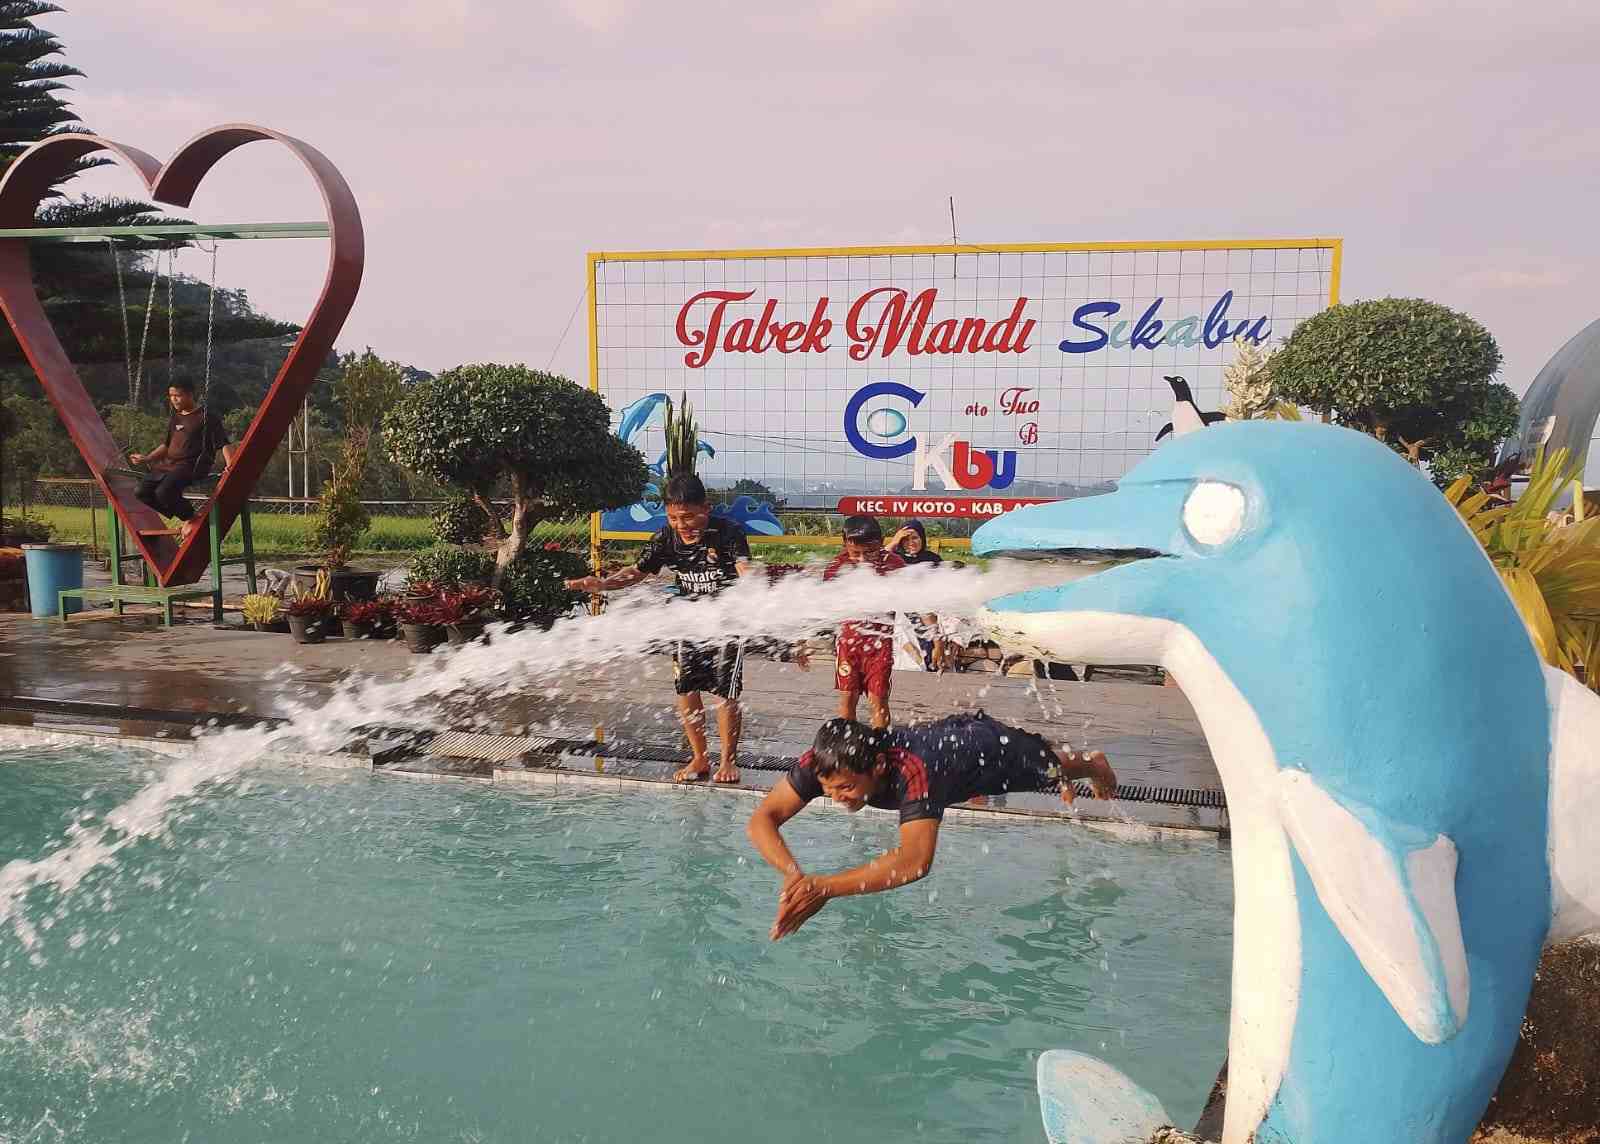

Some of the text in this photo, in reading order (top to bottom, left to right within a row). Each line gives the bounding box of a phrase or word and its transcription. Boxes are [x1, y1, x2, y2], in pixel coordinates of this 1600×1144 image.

[676, 287, 1273, 368] Tabek Mandi Sikabu
[1000, 387, 1040, 416] Tuo
[856, 500, 888, 513] KEC.
[892, 501, 909, 513] IV
[912, 500, 956, 514] KOTO
